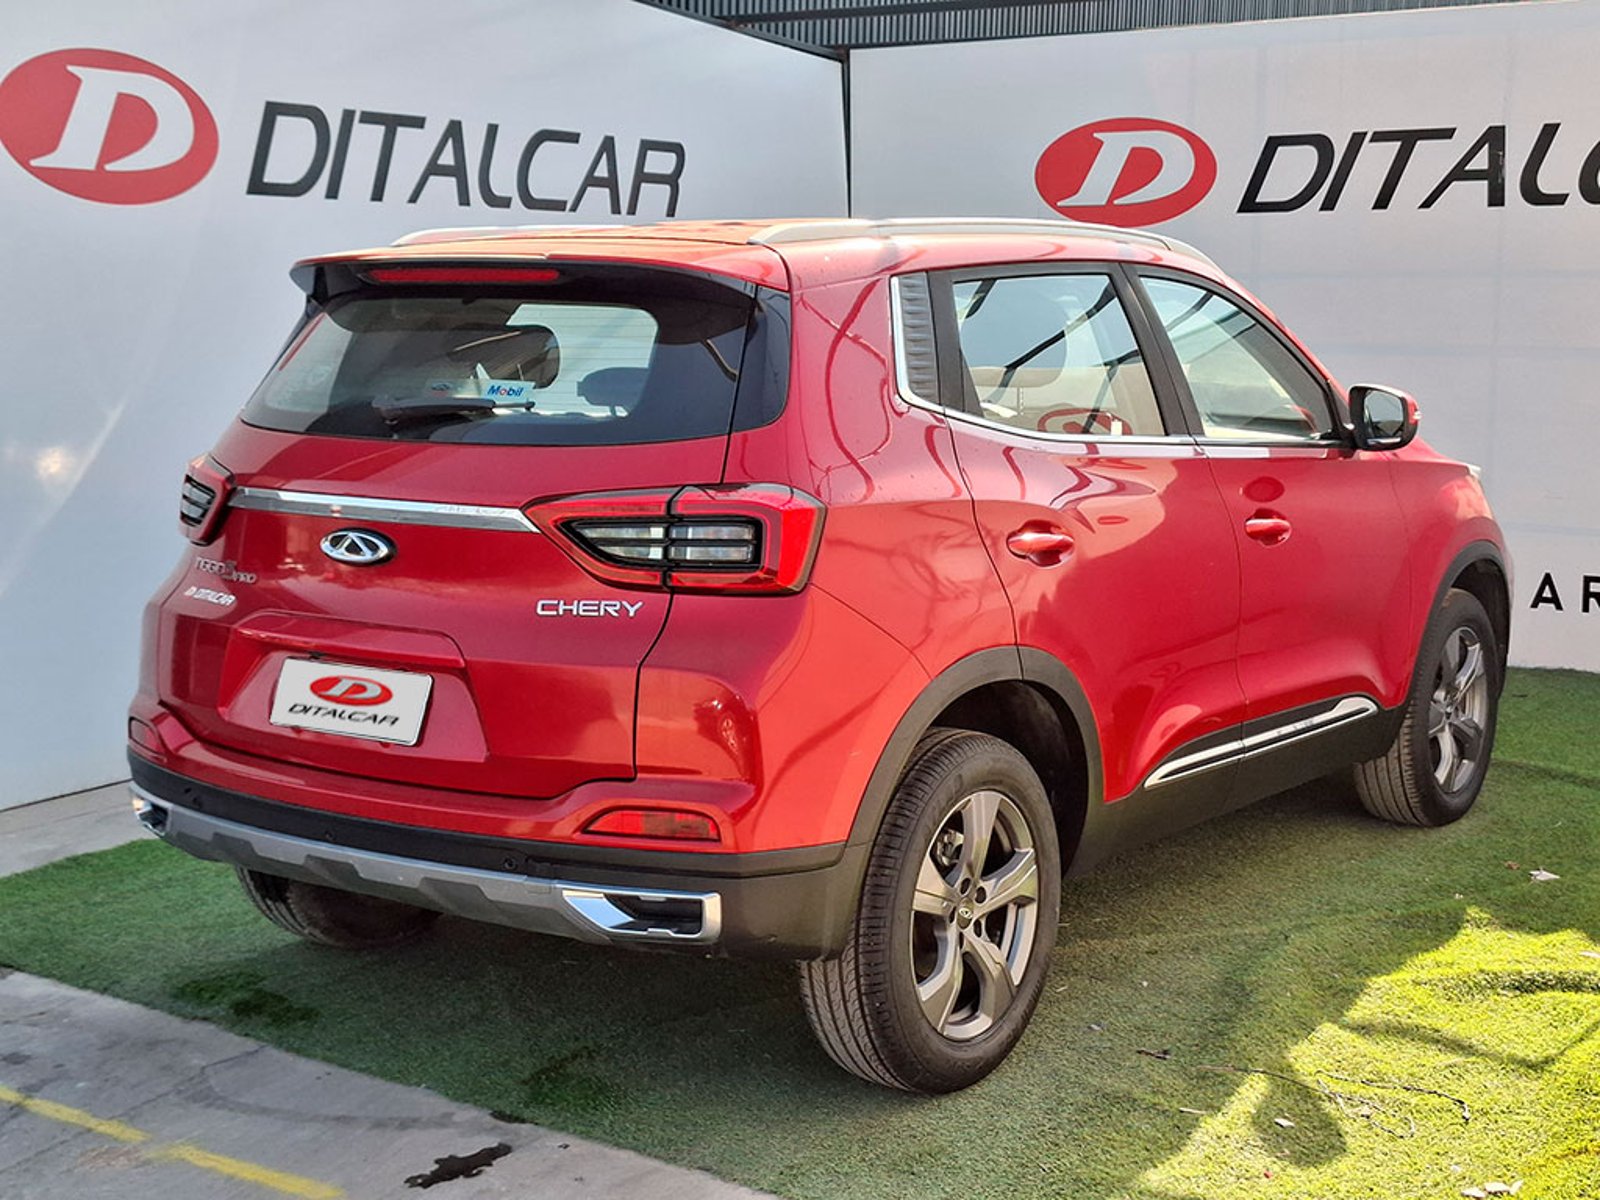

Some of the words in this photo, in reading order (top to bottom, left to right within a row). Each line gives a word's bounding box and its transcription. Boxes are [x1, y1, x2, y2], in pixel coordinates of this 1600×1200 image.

[29, 64, 196, 172] D
[247, 101, 685, 218] DITALCAR
[1056, 129, 1196, 207] D
[487, 384, 525, 397] Mobil
[536, 598, 643, 618] CHERY
[287, 703, 400, 727] DITALCAR
